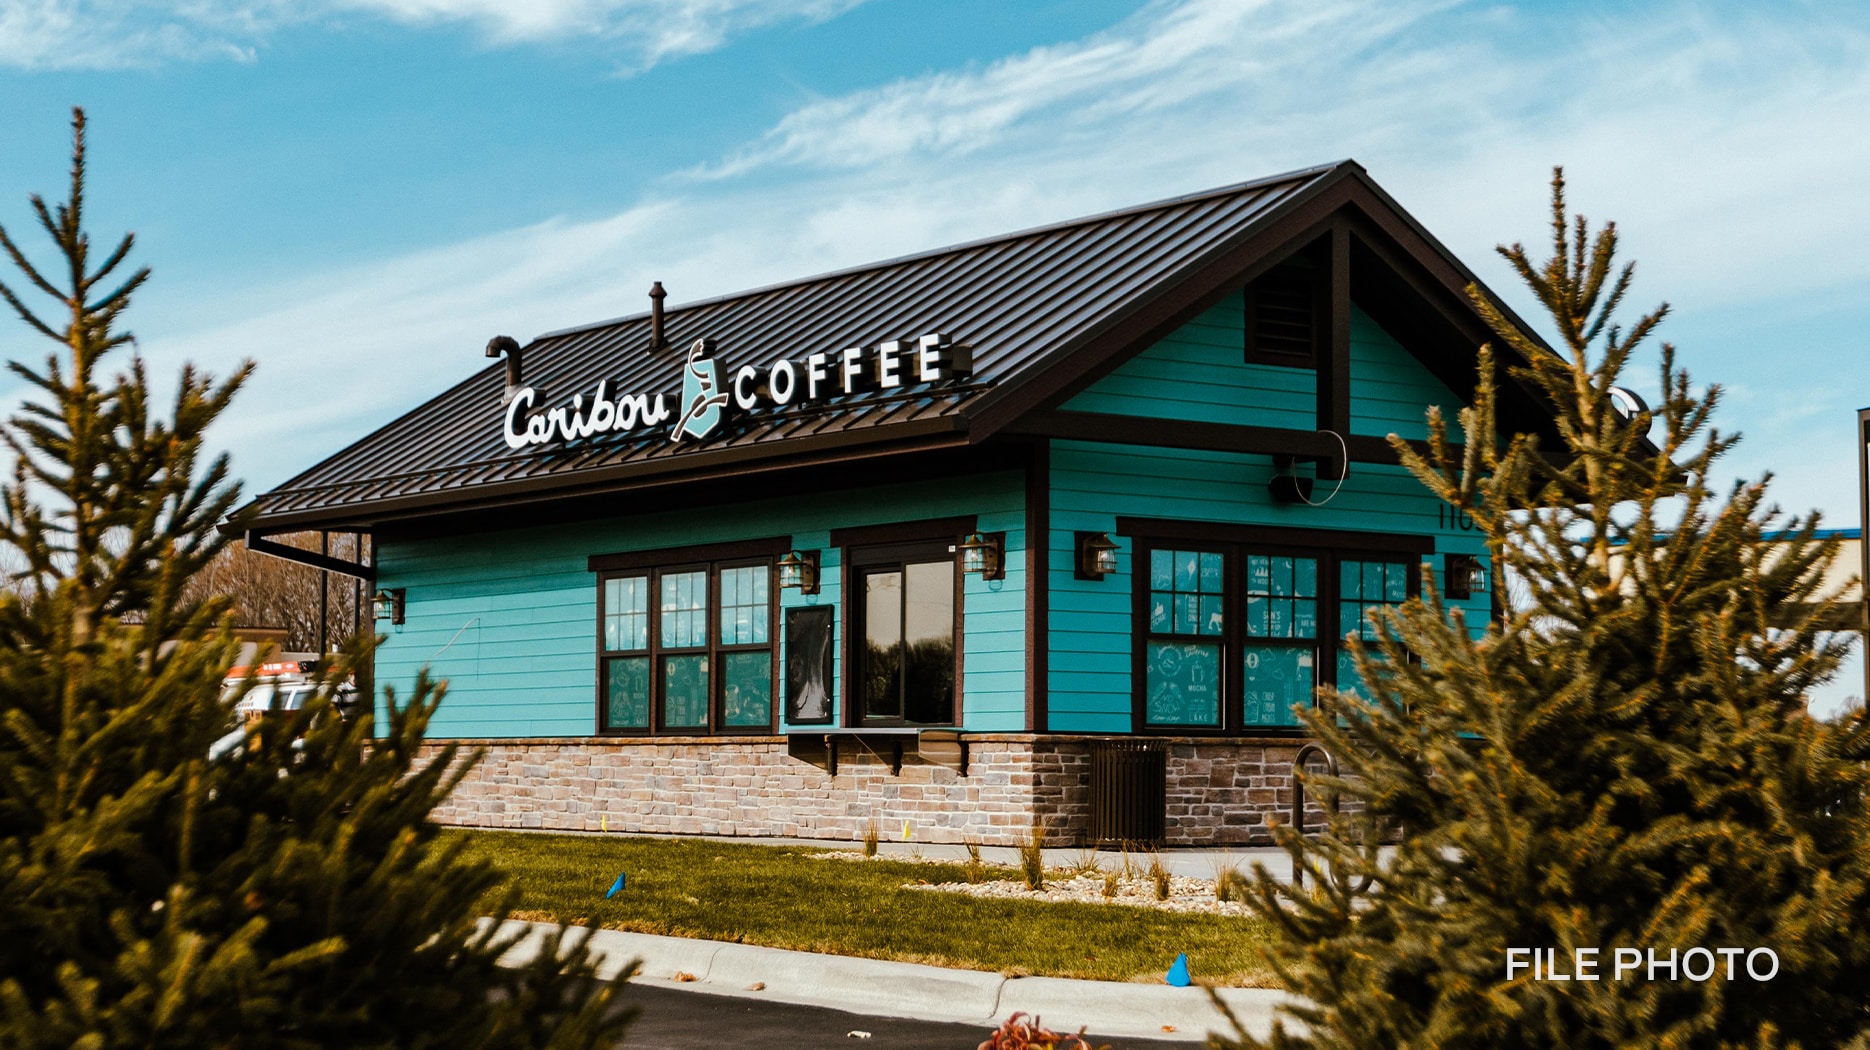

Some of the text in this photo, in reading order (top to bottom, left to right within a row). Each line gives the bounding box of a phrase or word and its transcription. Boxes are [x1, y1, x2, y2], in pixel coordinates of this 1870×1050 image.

[504, 333, 946, 449] Caribou COFFEE
[1439, 503, 1484, 531] 110
[1189, 713, 1208, 722] LAKE
